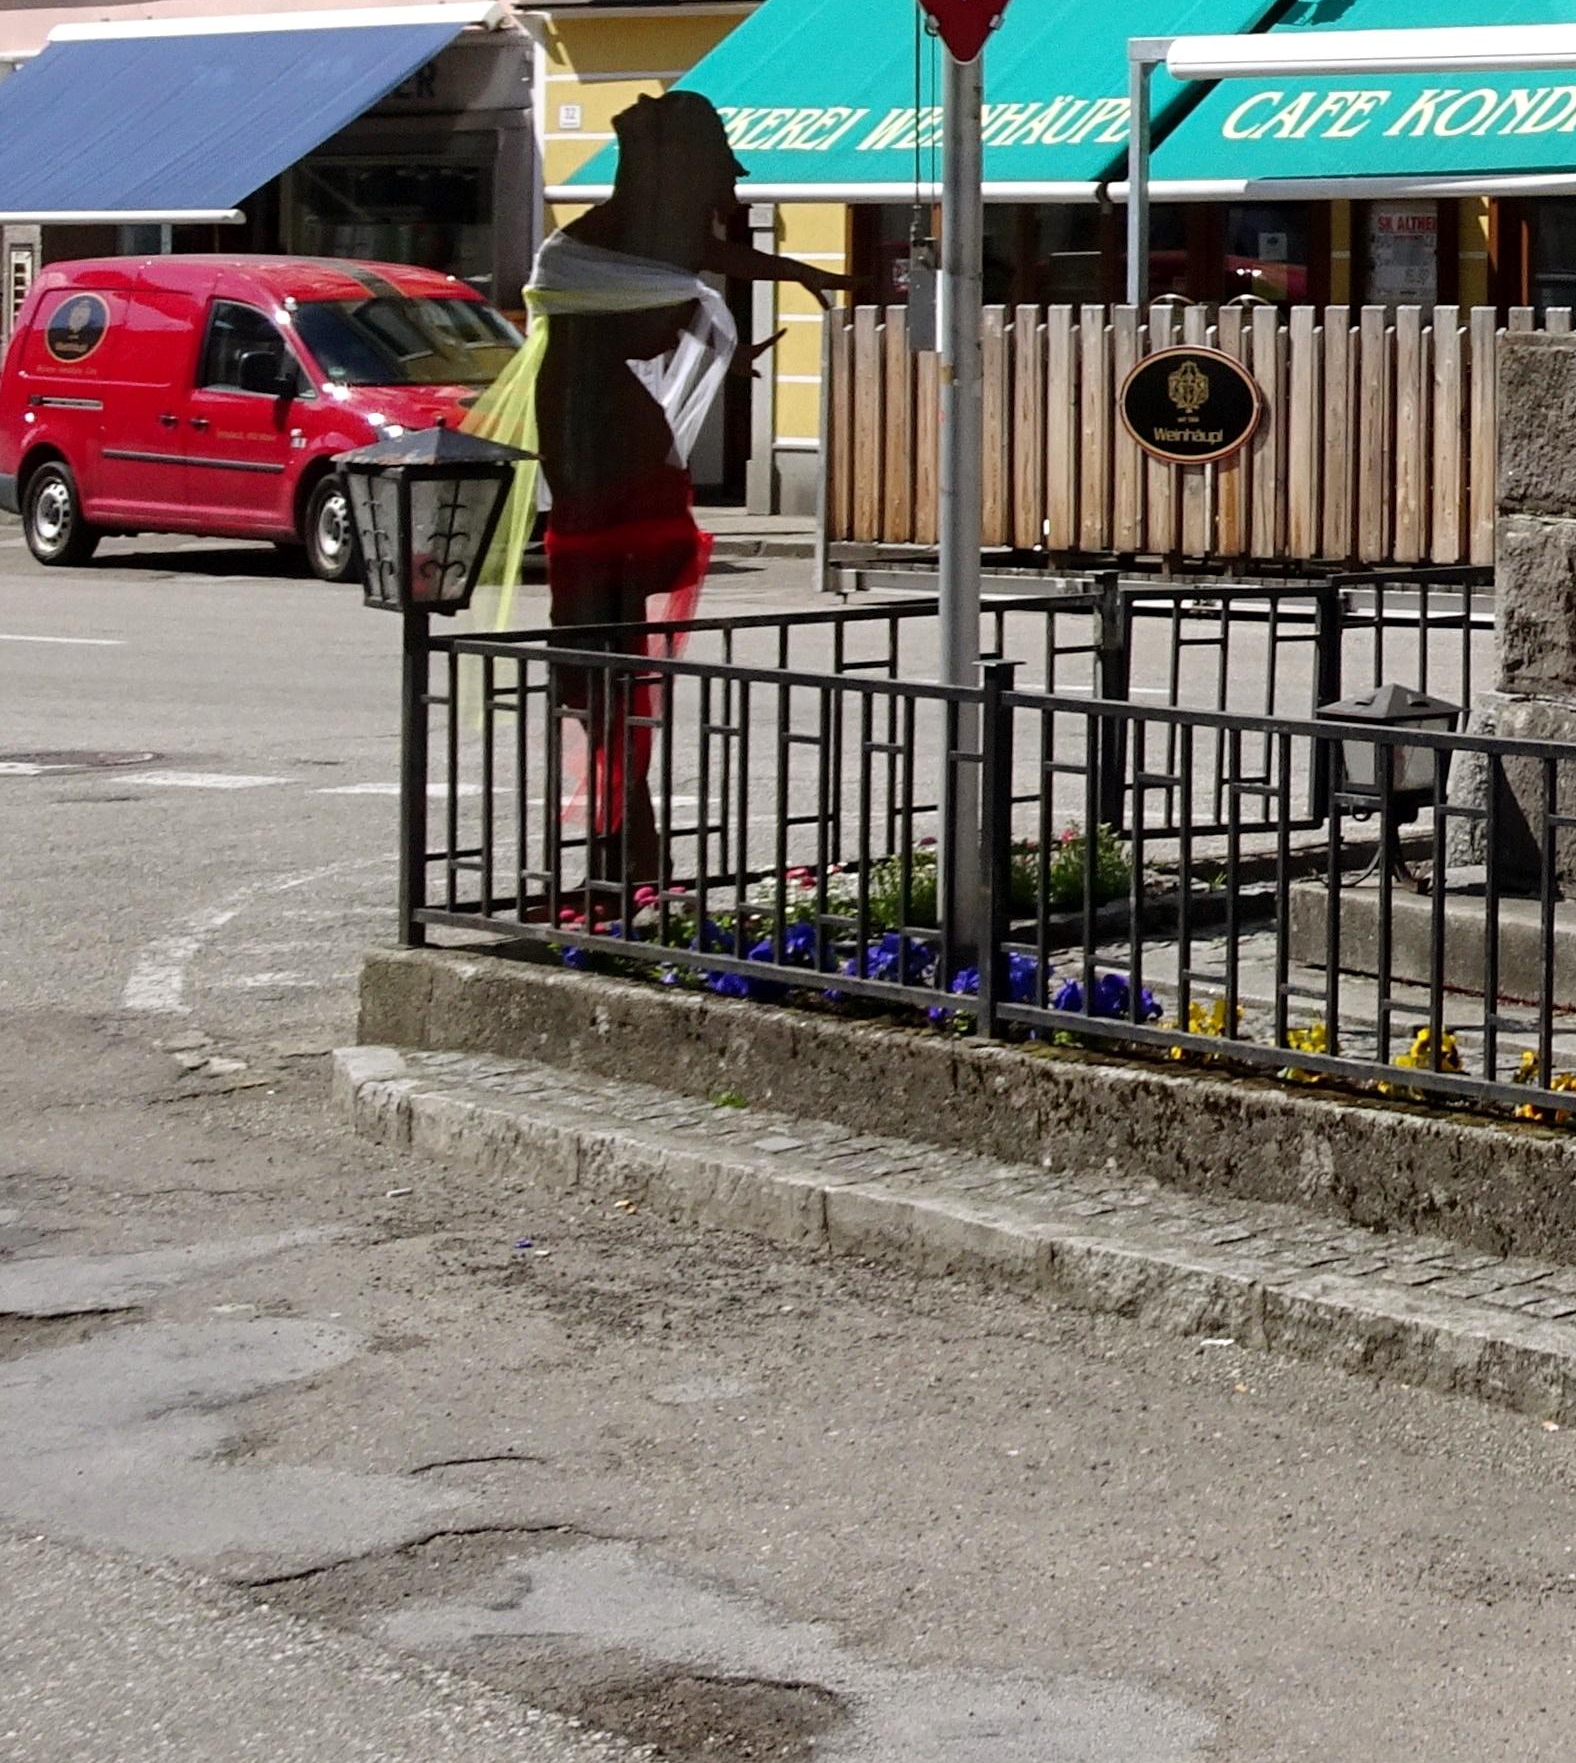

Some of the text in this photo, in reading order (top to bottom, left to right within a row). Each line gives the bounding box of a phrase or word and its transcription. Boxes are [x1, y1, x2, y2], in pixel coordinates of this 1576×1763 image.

[855, 95, 1131, 151] WENHÄUPL
[1222, 90, 1392, 140] CAFE
[1153, 426, 1224, 446] Weinhäupl
